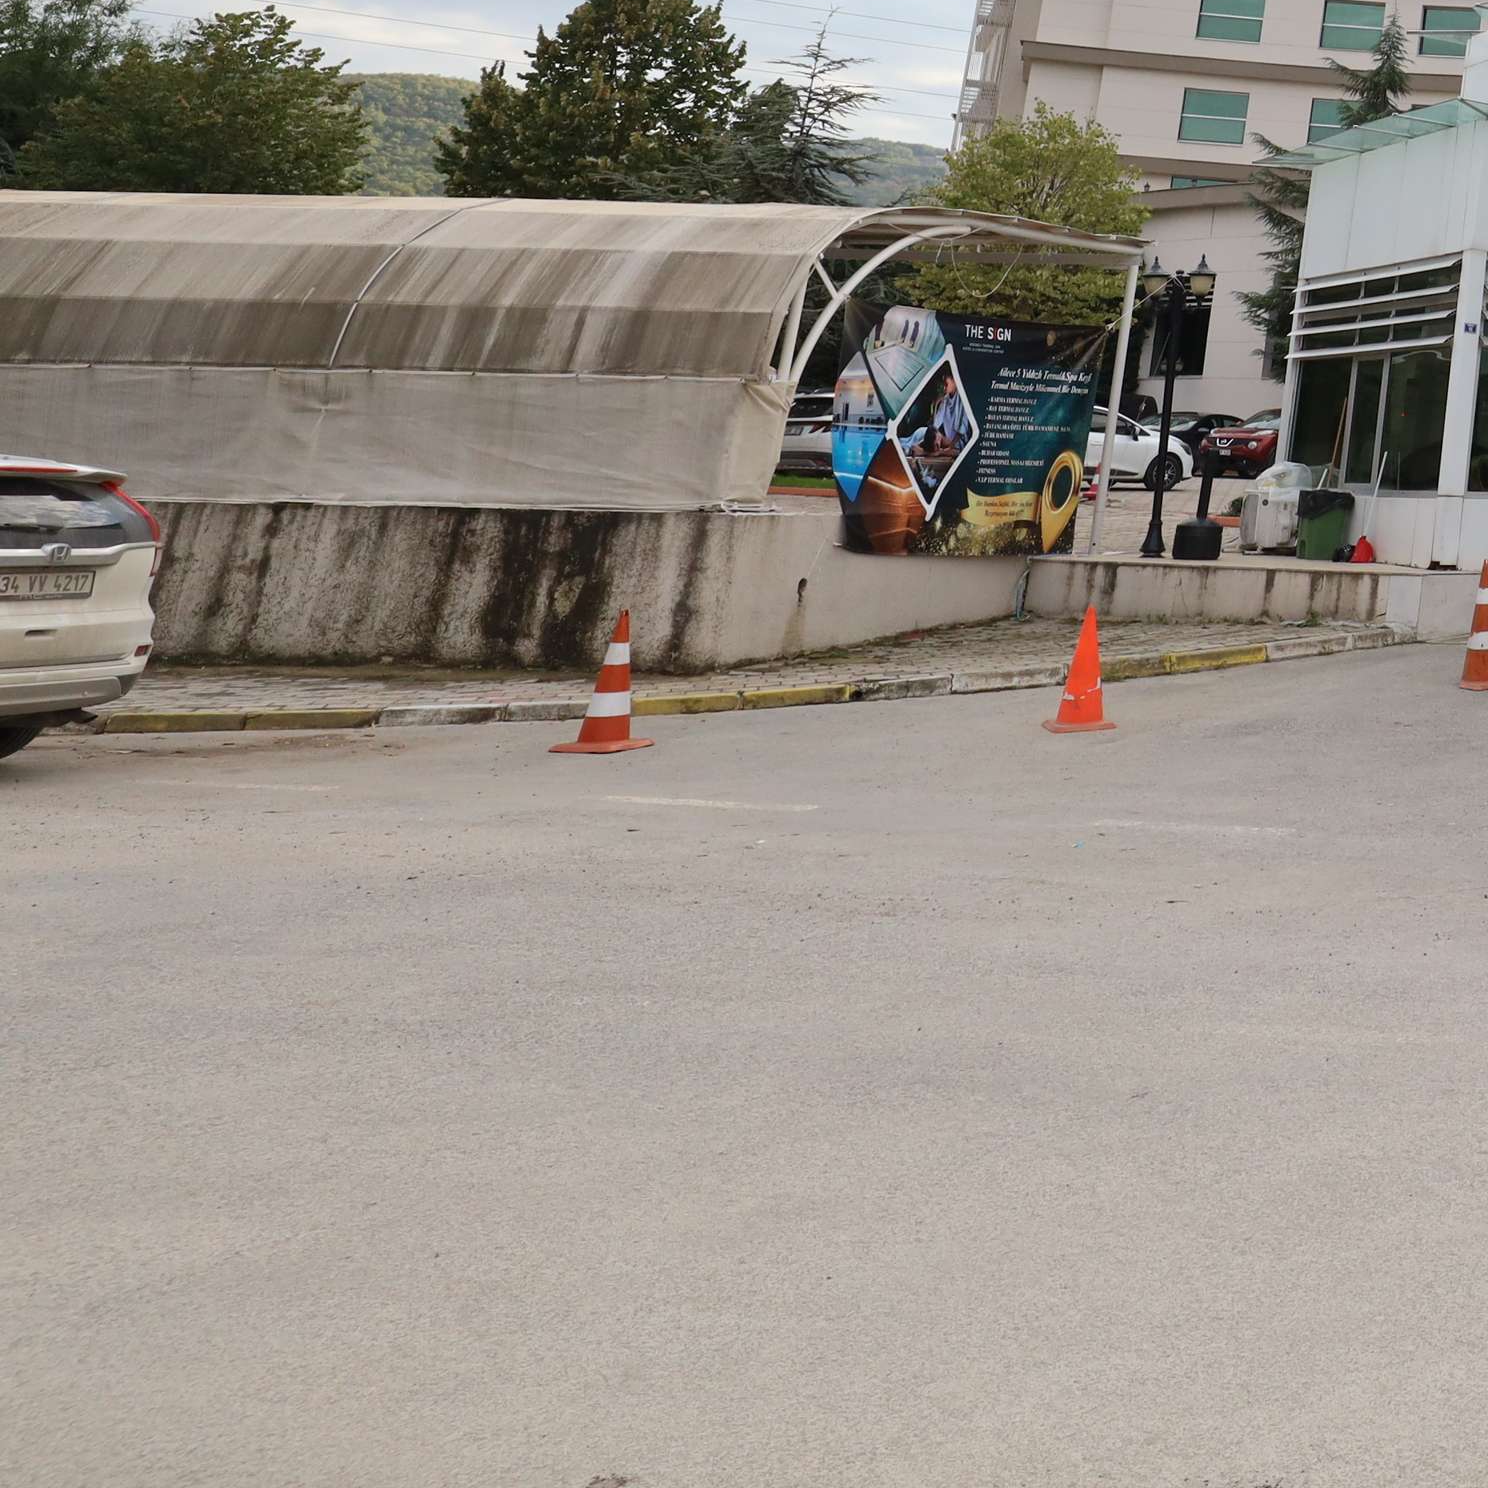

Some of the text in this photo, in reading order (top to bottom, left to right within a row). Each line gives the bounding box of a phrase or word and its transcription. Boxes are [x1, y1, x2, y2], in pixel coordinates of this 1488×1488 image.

[964, 324, 1012, 342] THE SIGN
[0, 574, 89, 593] 34 VV 4217
